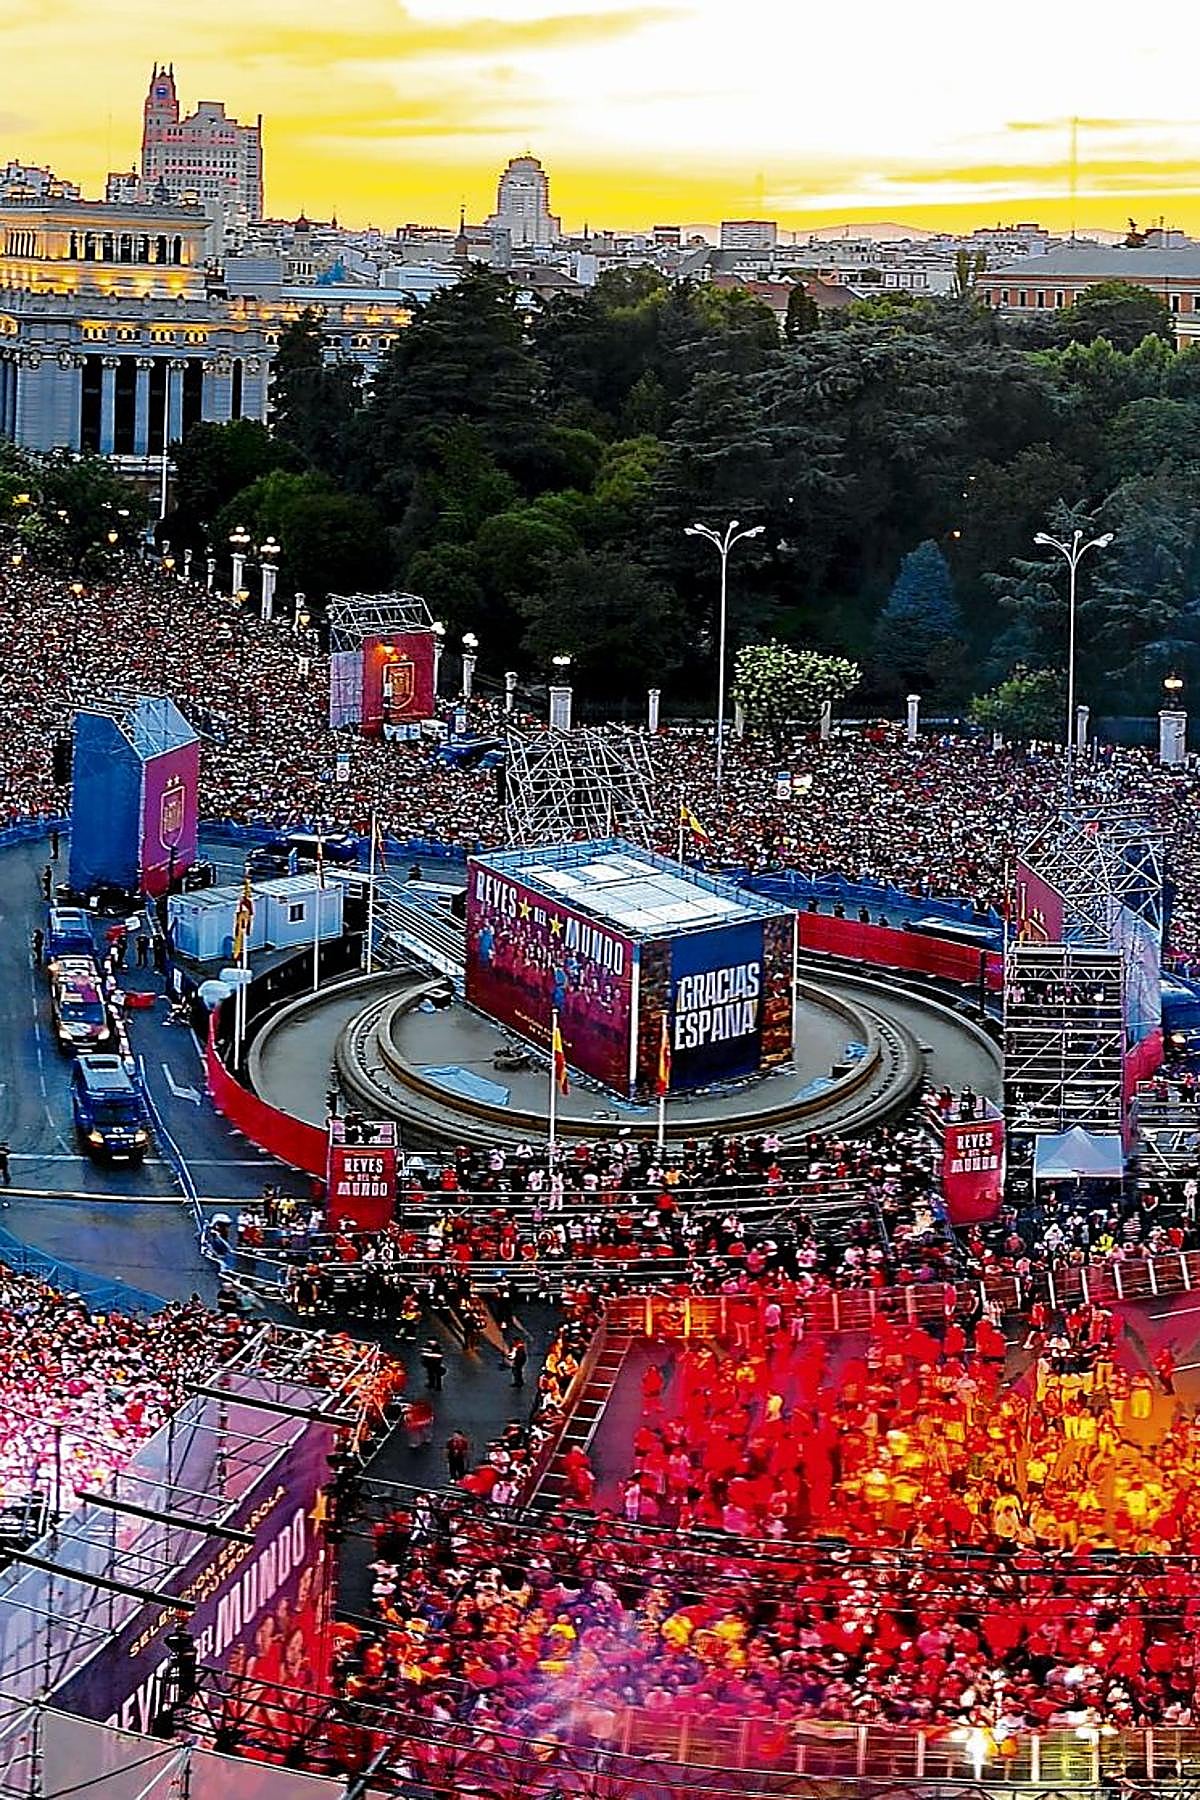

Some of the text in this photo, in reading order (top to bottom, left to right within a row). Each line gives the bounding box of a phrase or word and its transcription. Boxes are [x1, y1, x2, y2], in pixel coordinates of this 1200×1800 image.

[476, 870, 517, 918] REYES
[565, 916, 624, 976] MUNDO
[957, 1133, 993, 1149] REYES
[343, 1158, 384, 1172] REYES
[951, 1156, 998, 1173] MUNDO
[337, 1182, 388, 1196] MUNDO
[214, 1508, 305, 1658] MUNDO
